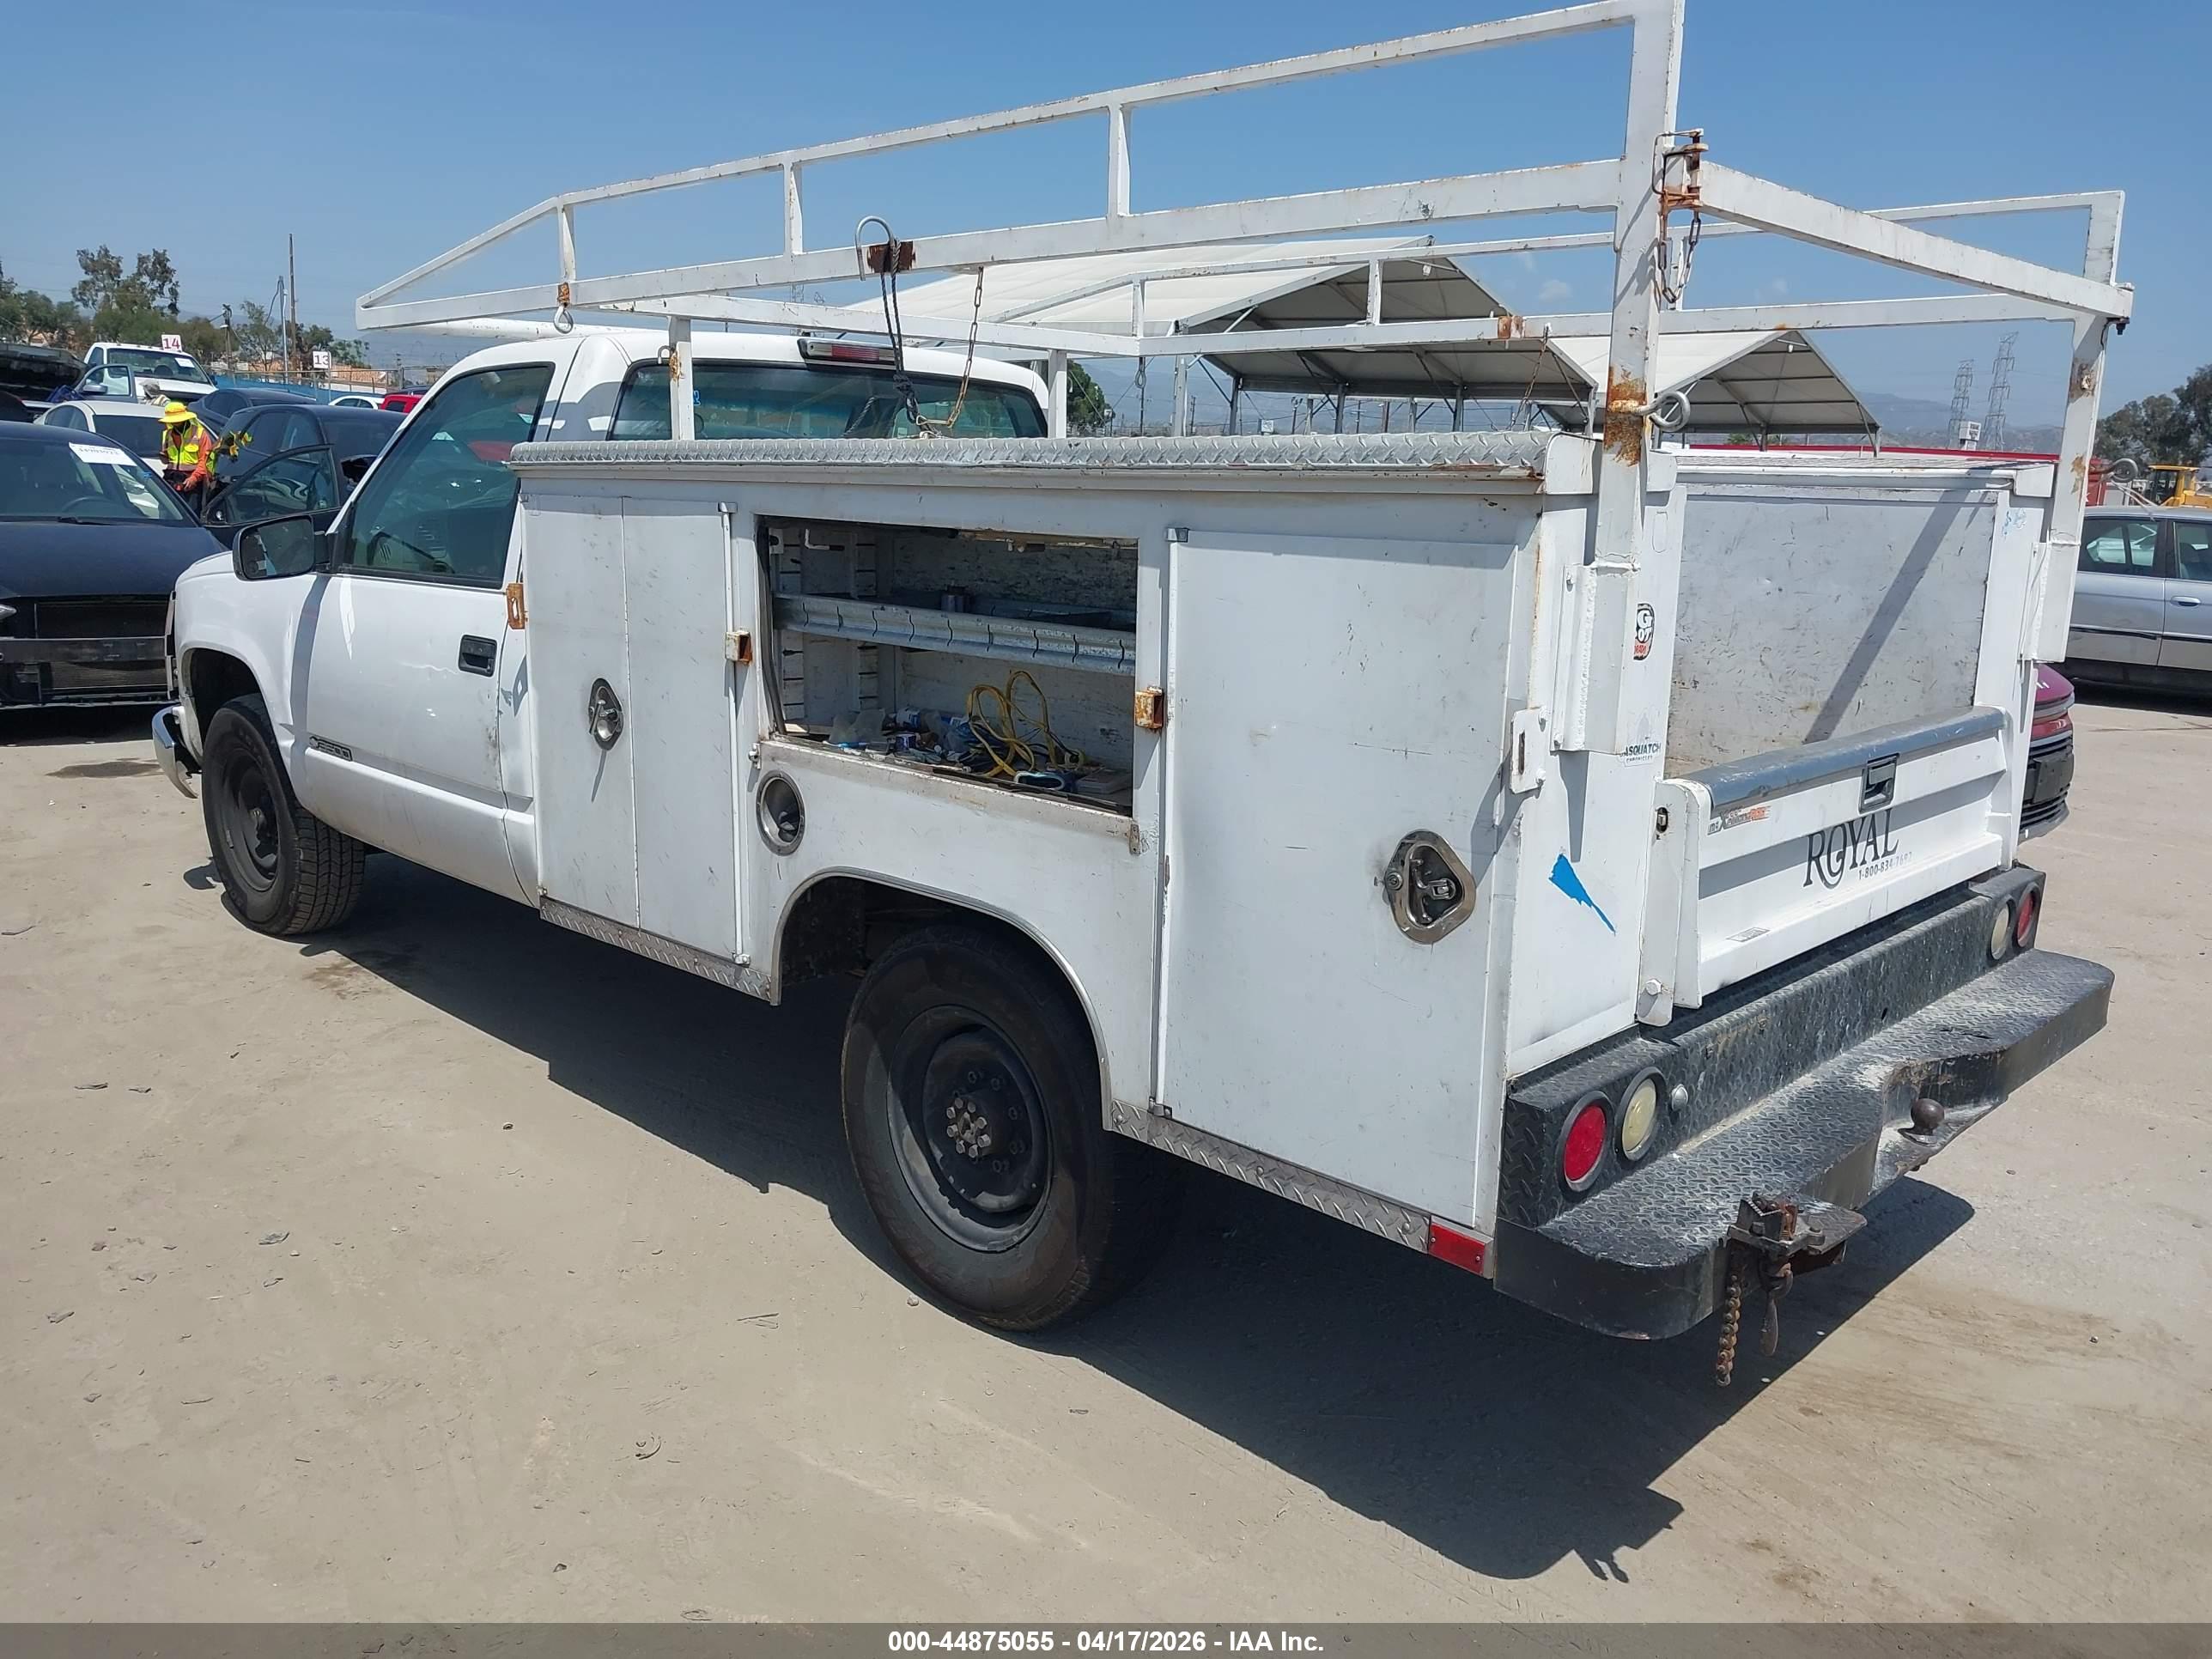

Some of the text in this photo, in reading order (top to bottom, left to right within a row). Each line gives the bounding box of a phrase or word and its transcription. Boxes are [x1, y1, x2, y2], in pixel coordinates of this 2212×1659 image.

[162, 337, 179, 349] 14
[314, 355, 329, 365] 13
[1803, 807, 1899, 890] ROYAL
